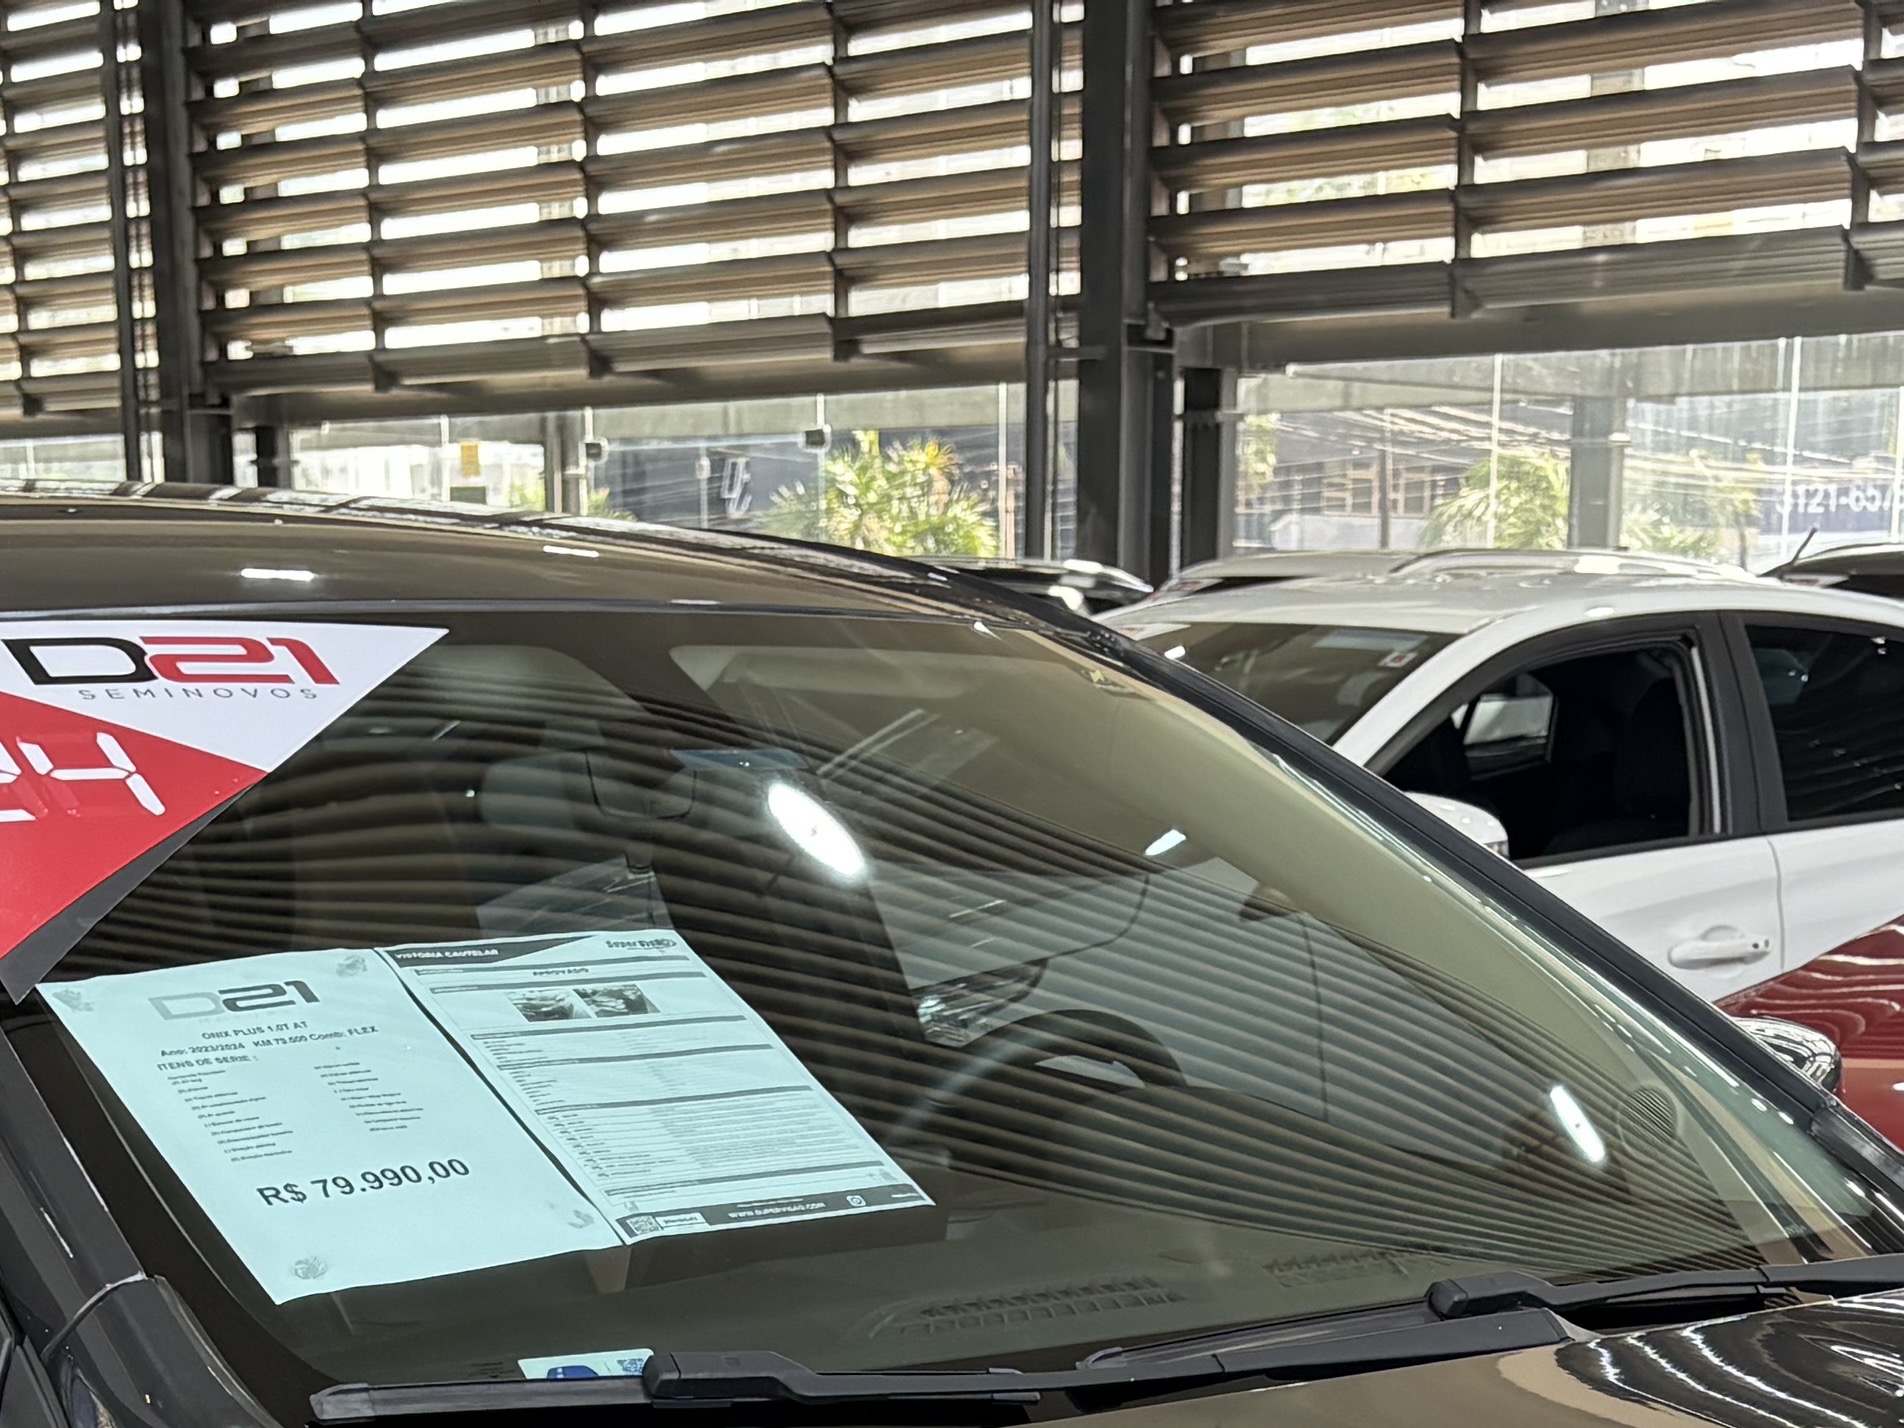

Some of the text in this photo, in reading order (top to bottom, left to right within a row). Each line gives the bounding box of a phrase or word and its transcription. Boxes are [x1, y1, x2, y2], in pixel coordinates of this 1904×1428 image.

[1, 636, 340, 686] D21
[78, 687, 318, 700] SEMINOVOS
[148, 980, 321, 1021] D21
[234, 1026, 265, 1037] PLUS
[293, 1020, 308, 1030] AT
[347, 1025, 379, 1036] FLEX
[256, 1158, 470, 1206] R$ 79.990,00
